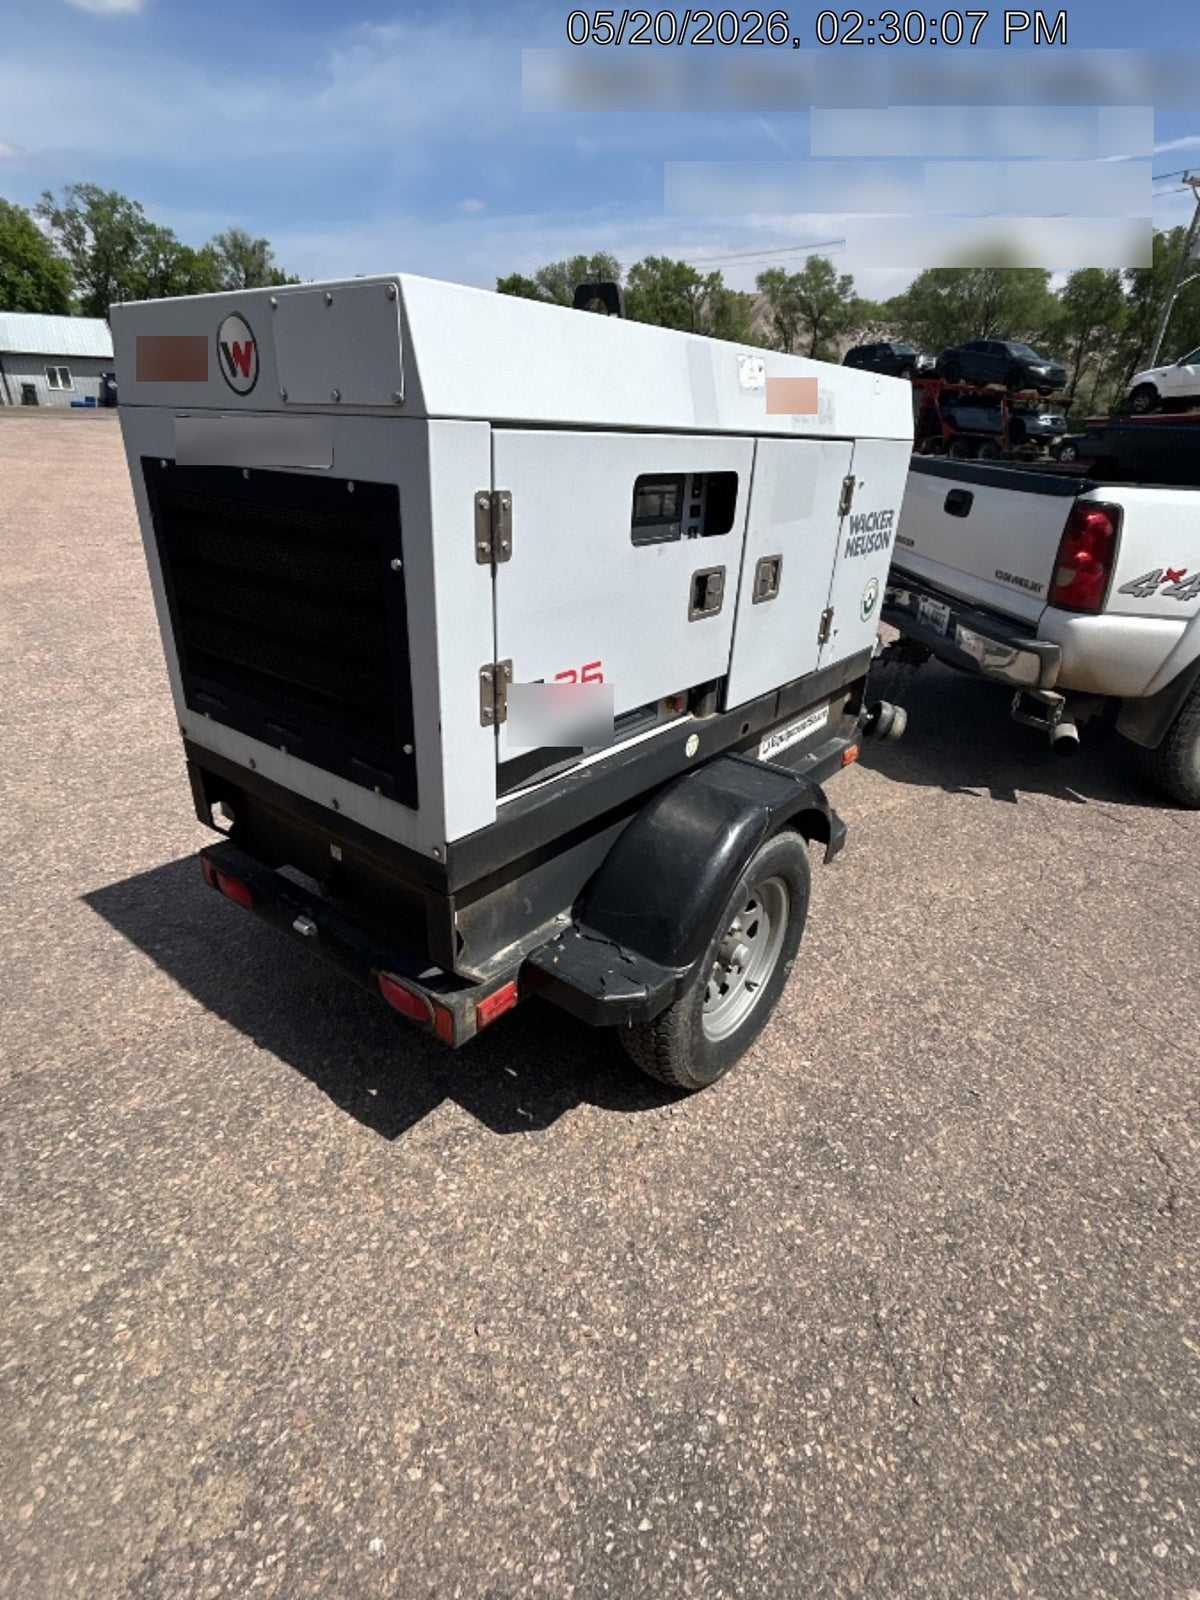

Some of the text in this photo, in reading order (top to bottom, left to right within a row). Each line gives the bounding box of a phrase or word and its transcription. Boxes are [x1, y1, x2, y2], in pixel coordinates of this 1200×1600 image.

[220, 341, 255, 378] W
[849, 509, 895, 536] WACKER
[844, 530, 892, 559] NEUSON
